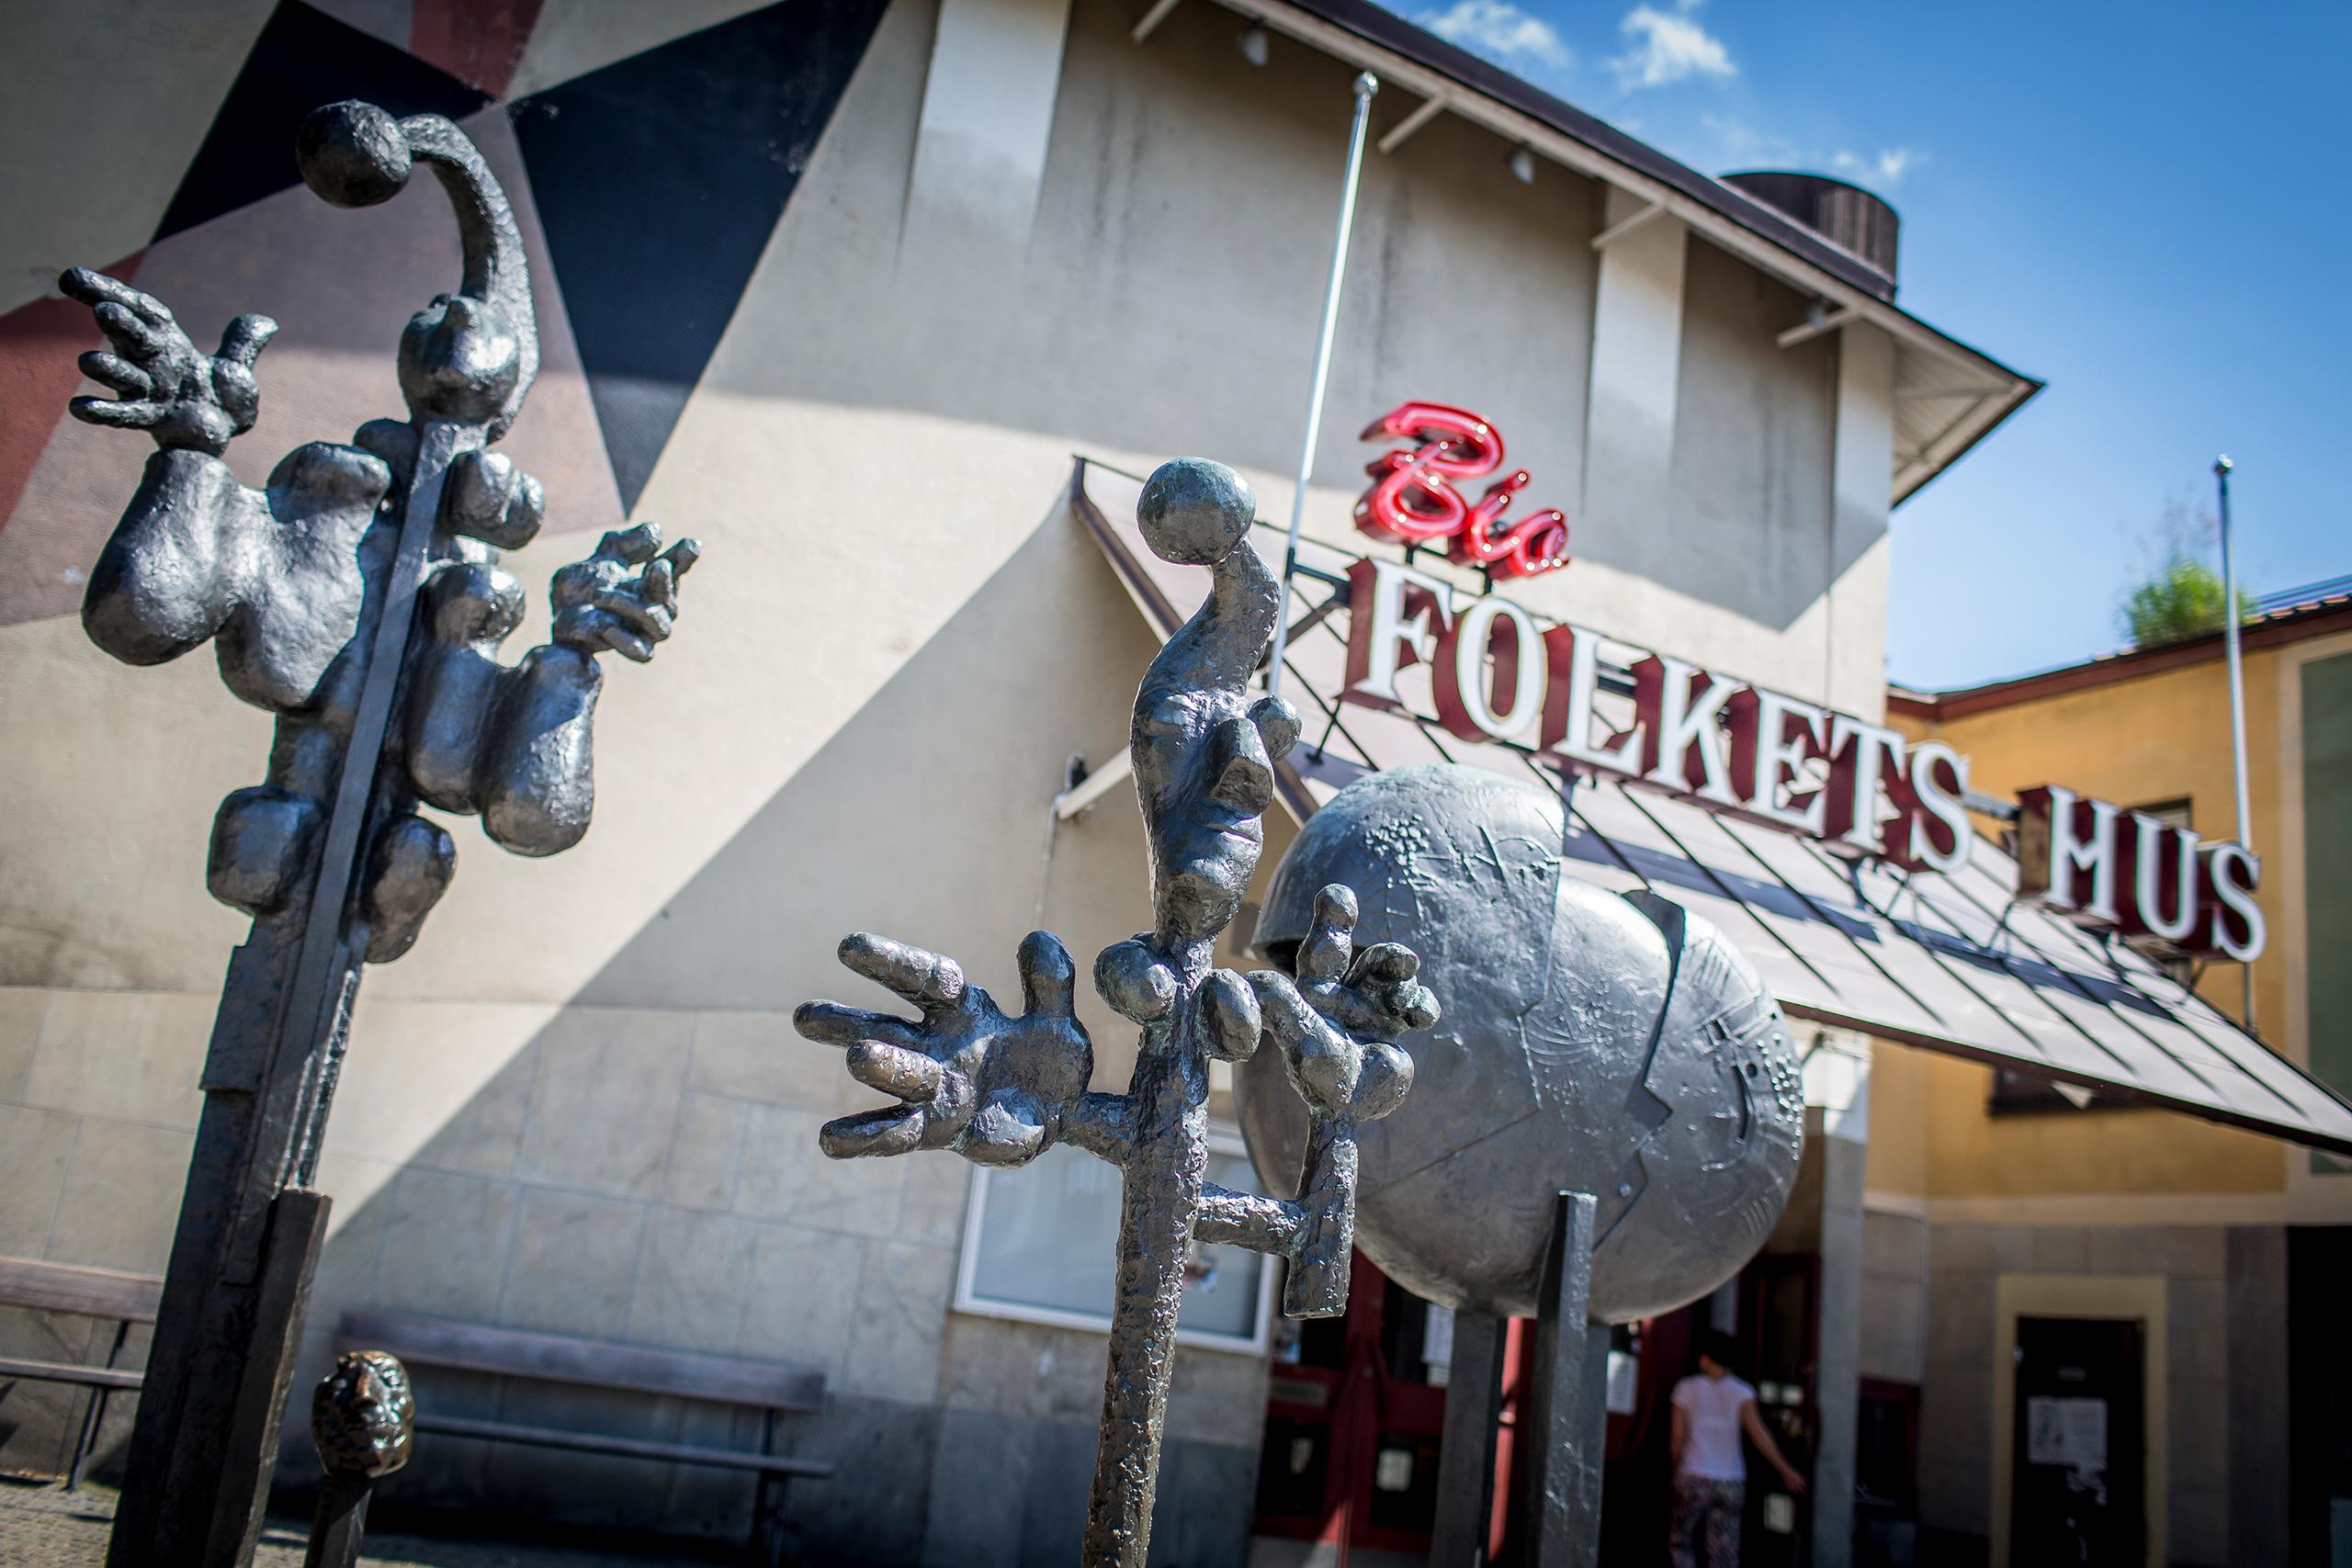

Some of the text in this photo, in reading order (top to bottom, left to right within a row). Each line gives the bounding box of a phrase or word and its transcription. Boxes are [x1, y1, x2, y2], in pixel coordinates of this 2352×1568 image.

[1355, 401, 1569, 581] Bio
[1353, 557, 2267, 963] FOLKETS HUS
